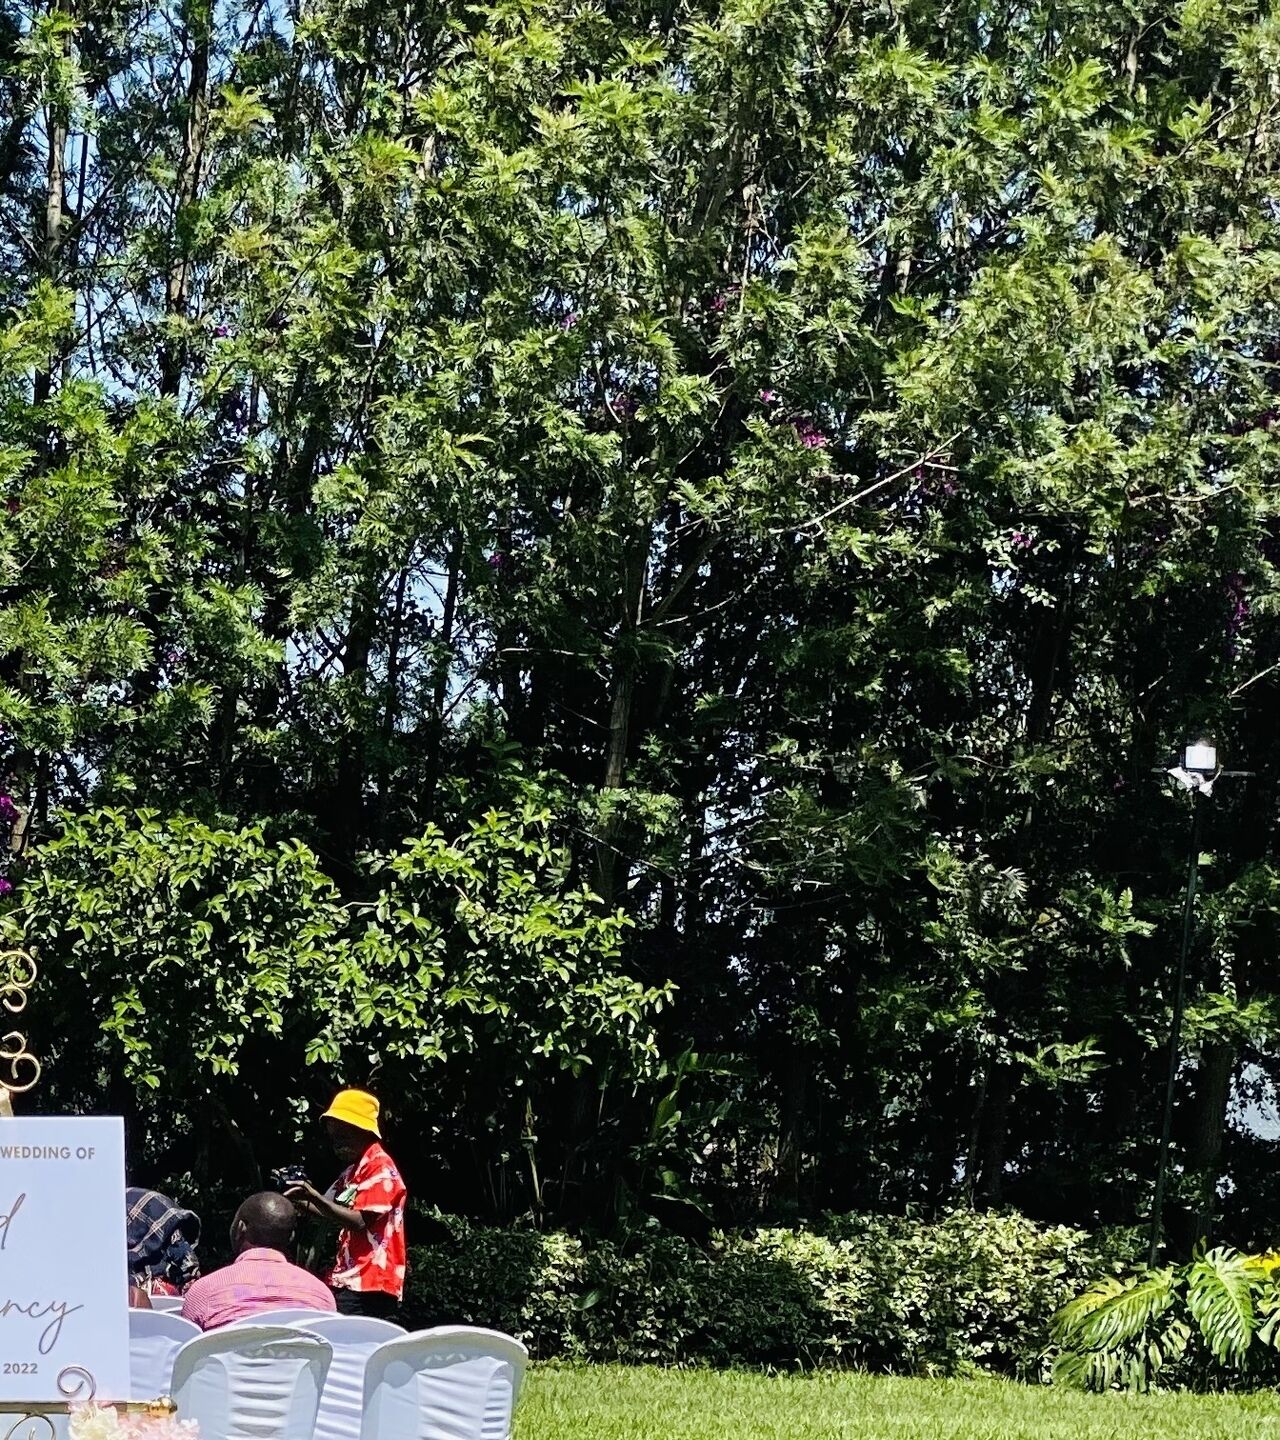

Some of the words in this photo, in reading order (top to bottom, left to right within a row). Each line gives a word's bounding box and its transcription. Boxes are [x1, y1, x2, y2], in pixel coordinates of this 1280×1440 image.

[0, 1146, 71, 1159] WEDDING
[76, 1147, 95, 1160] OF
[3, 1363, 39, 1374] 2022
